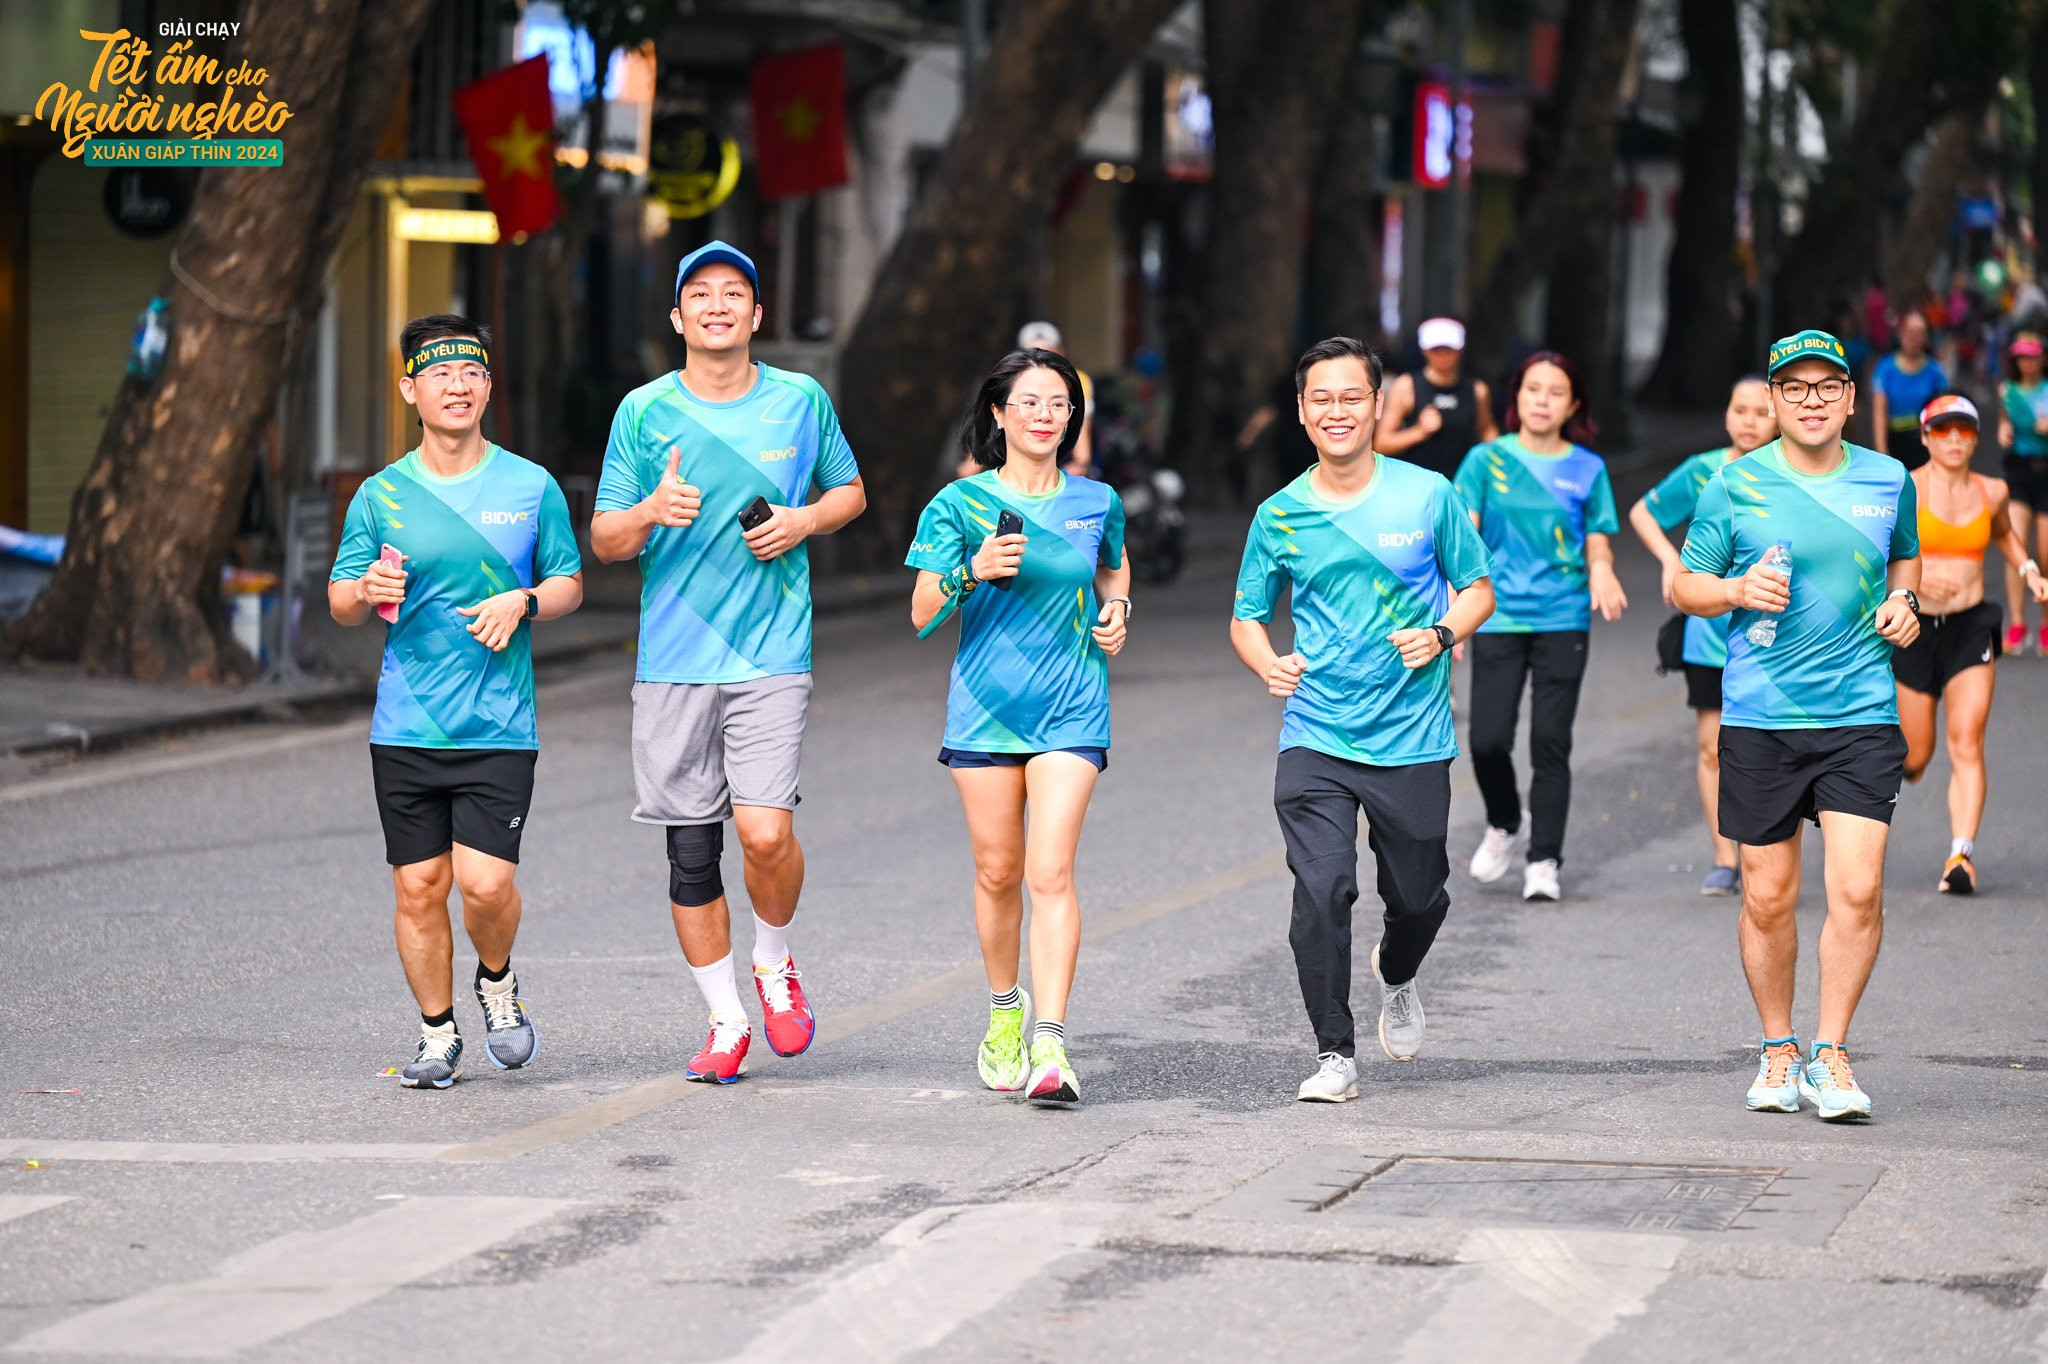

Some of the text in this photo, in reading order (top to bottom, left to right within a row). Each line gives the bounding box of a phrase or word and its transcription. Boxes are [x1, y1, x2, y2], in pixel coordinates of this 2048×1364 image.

[415, 343, 481, 366] TÔI YÊU BIDV
[1769, 350, 1779, 366] ÔI
[1804, 338, 1830, 350] BIDV
[760, 449, 787, 463] BIDV
[481, 511, 520, 525] BIDV
[1852, 505, 1887, 518] BIDV
[909, 541, 927, 553] DV
[1378, 532, 1415, 548] BIDV
